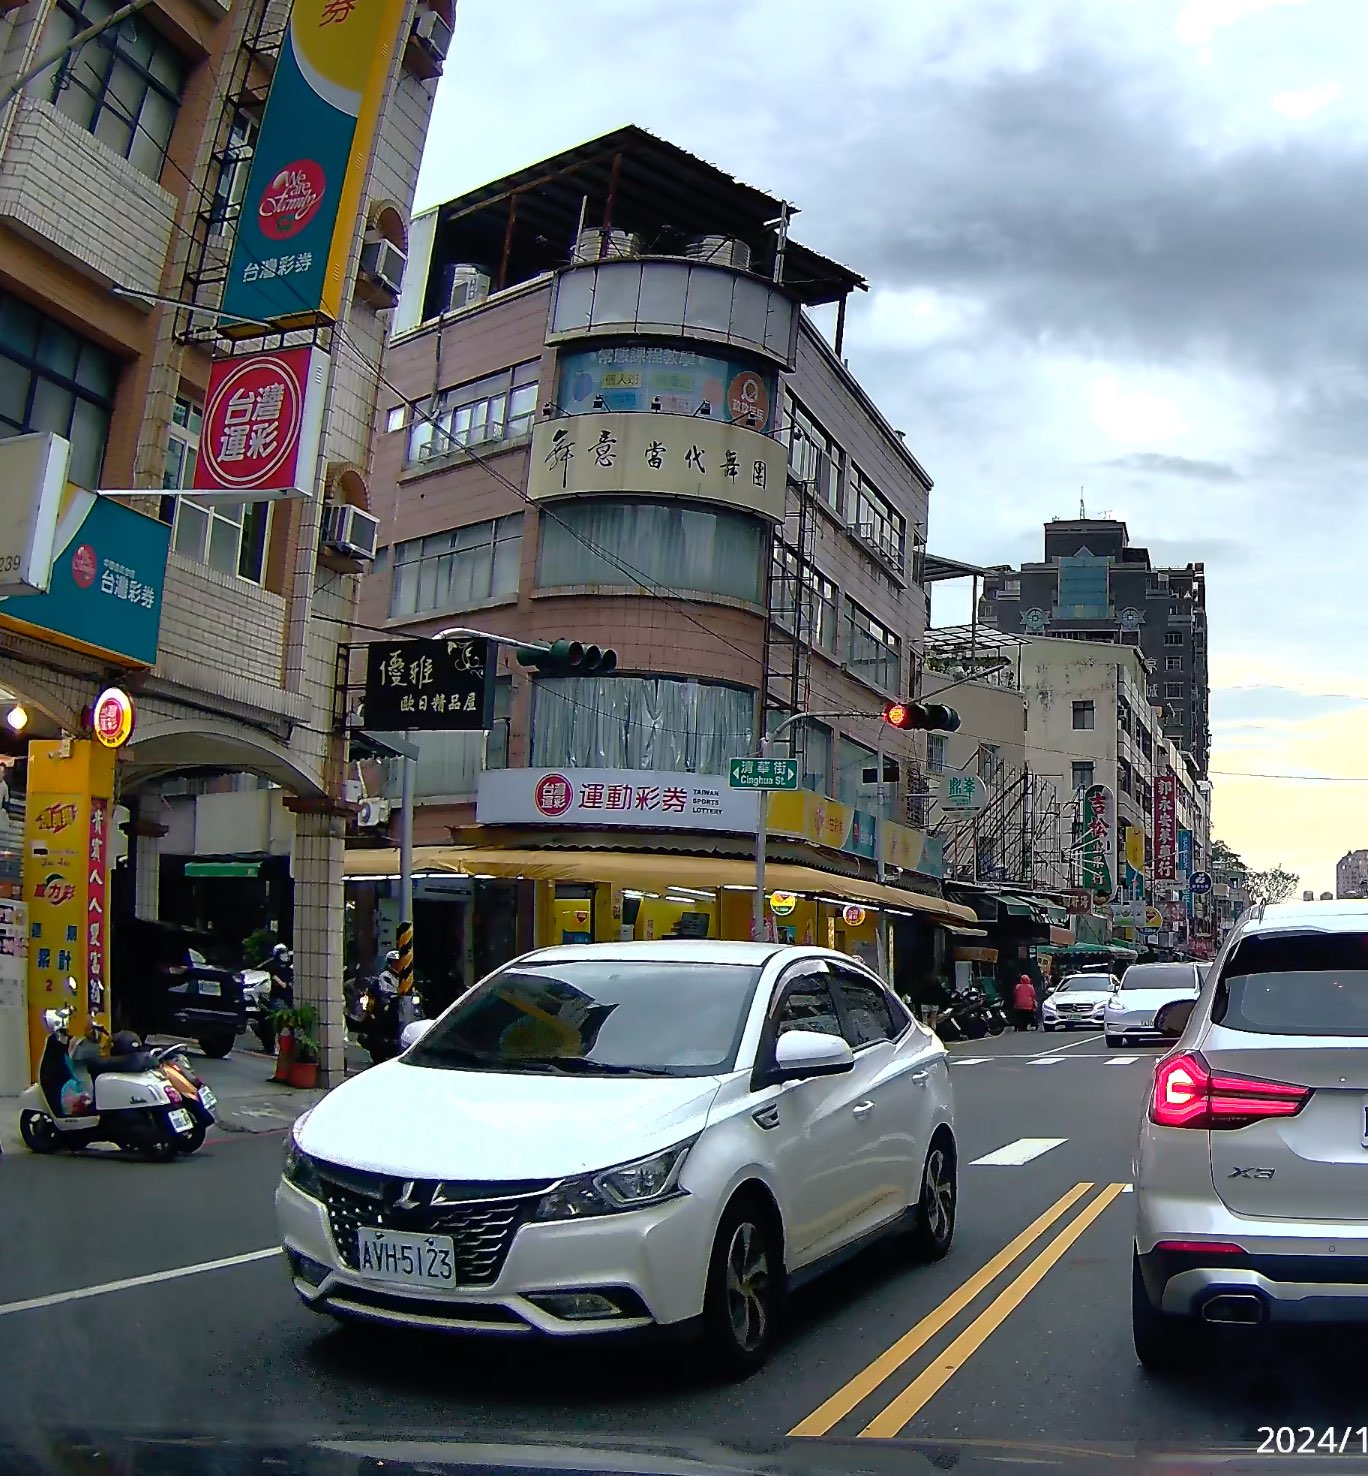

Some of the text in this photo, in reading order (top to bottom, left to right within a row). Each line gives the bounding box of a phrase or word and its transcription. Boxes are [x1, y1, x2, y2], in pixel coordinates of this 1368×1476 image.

[242, 251, 313, 282] 台灣彩券
[224, 382, 286, 426] 台灣
[217, 420, 279, 463] 運彩
[380, 650, 434, 690] 優雅
[400, 691, 477, 713] 歐日精品屋
[740, 760, 786, 775] 清華街
[740, 774, 773, 786] Cinghua
[578, 782, 688, 813] 運動彩券
[692, 788, 719, 797] TAIWAN
[692, 797, 719, 806] SPORTS
[692, 807, 722, 815] LOTTERY
[1228, 1166, 1276, 1180] X3
